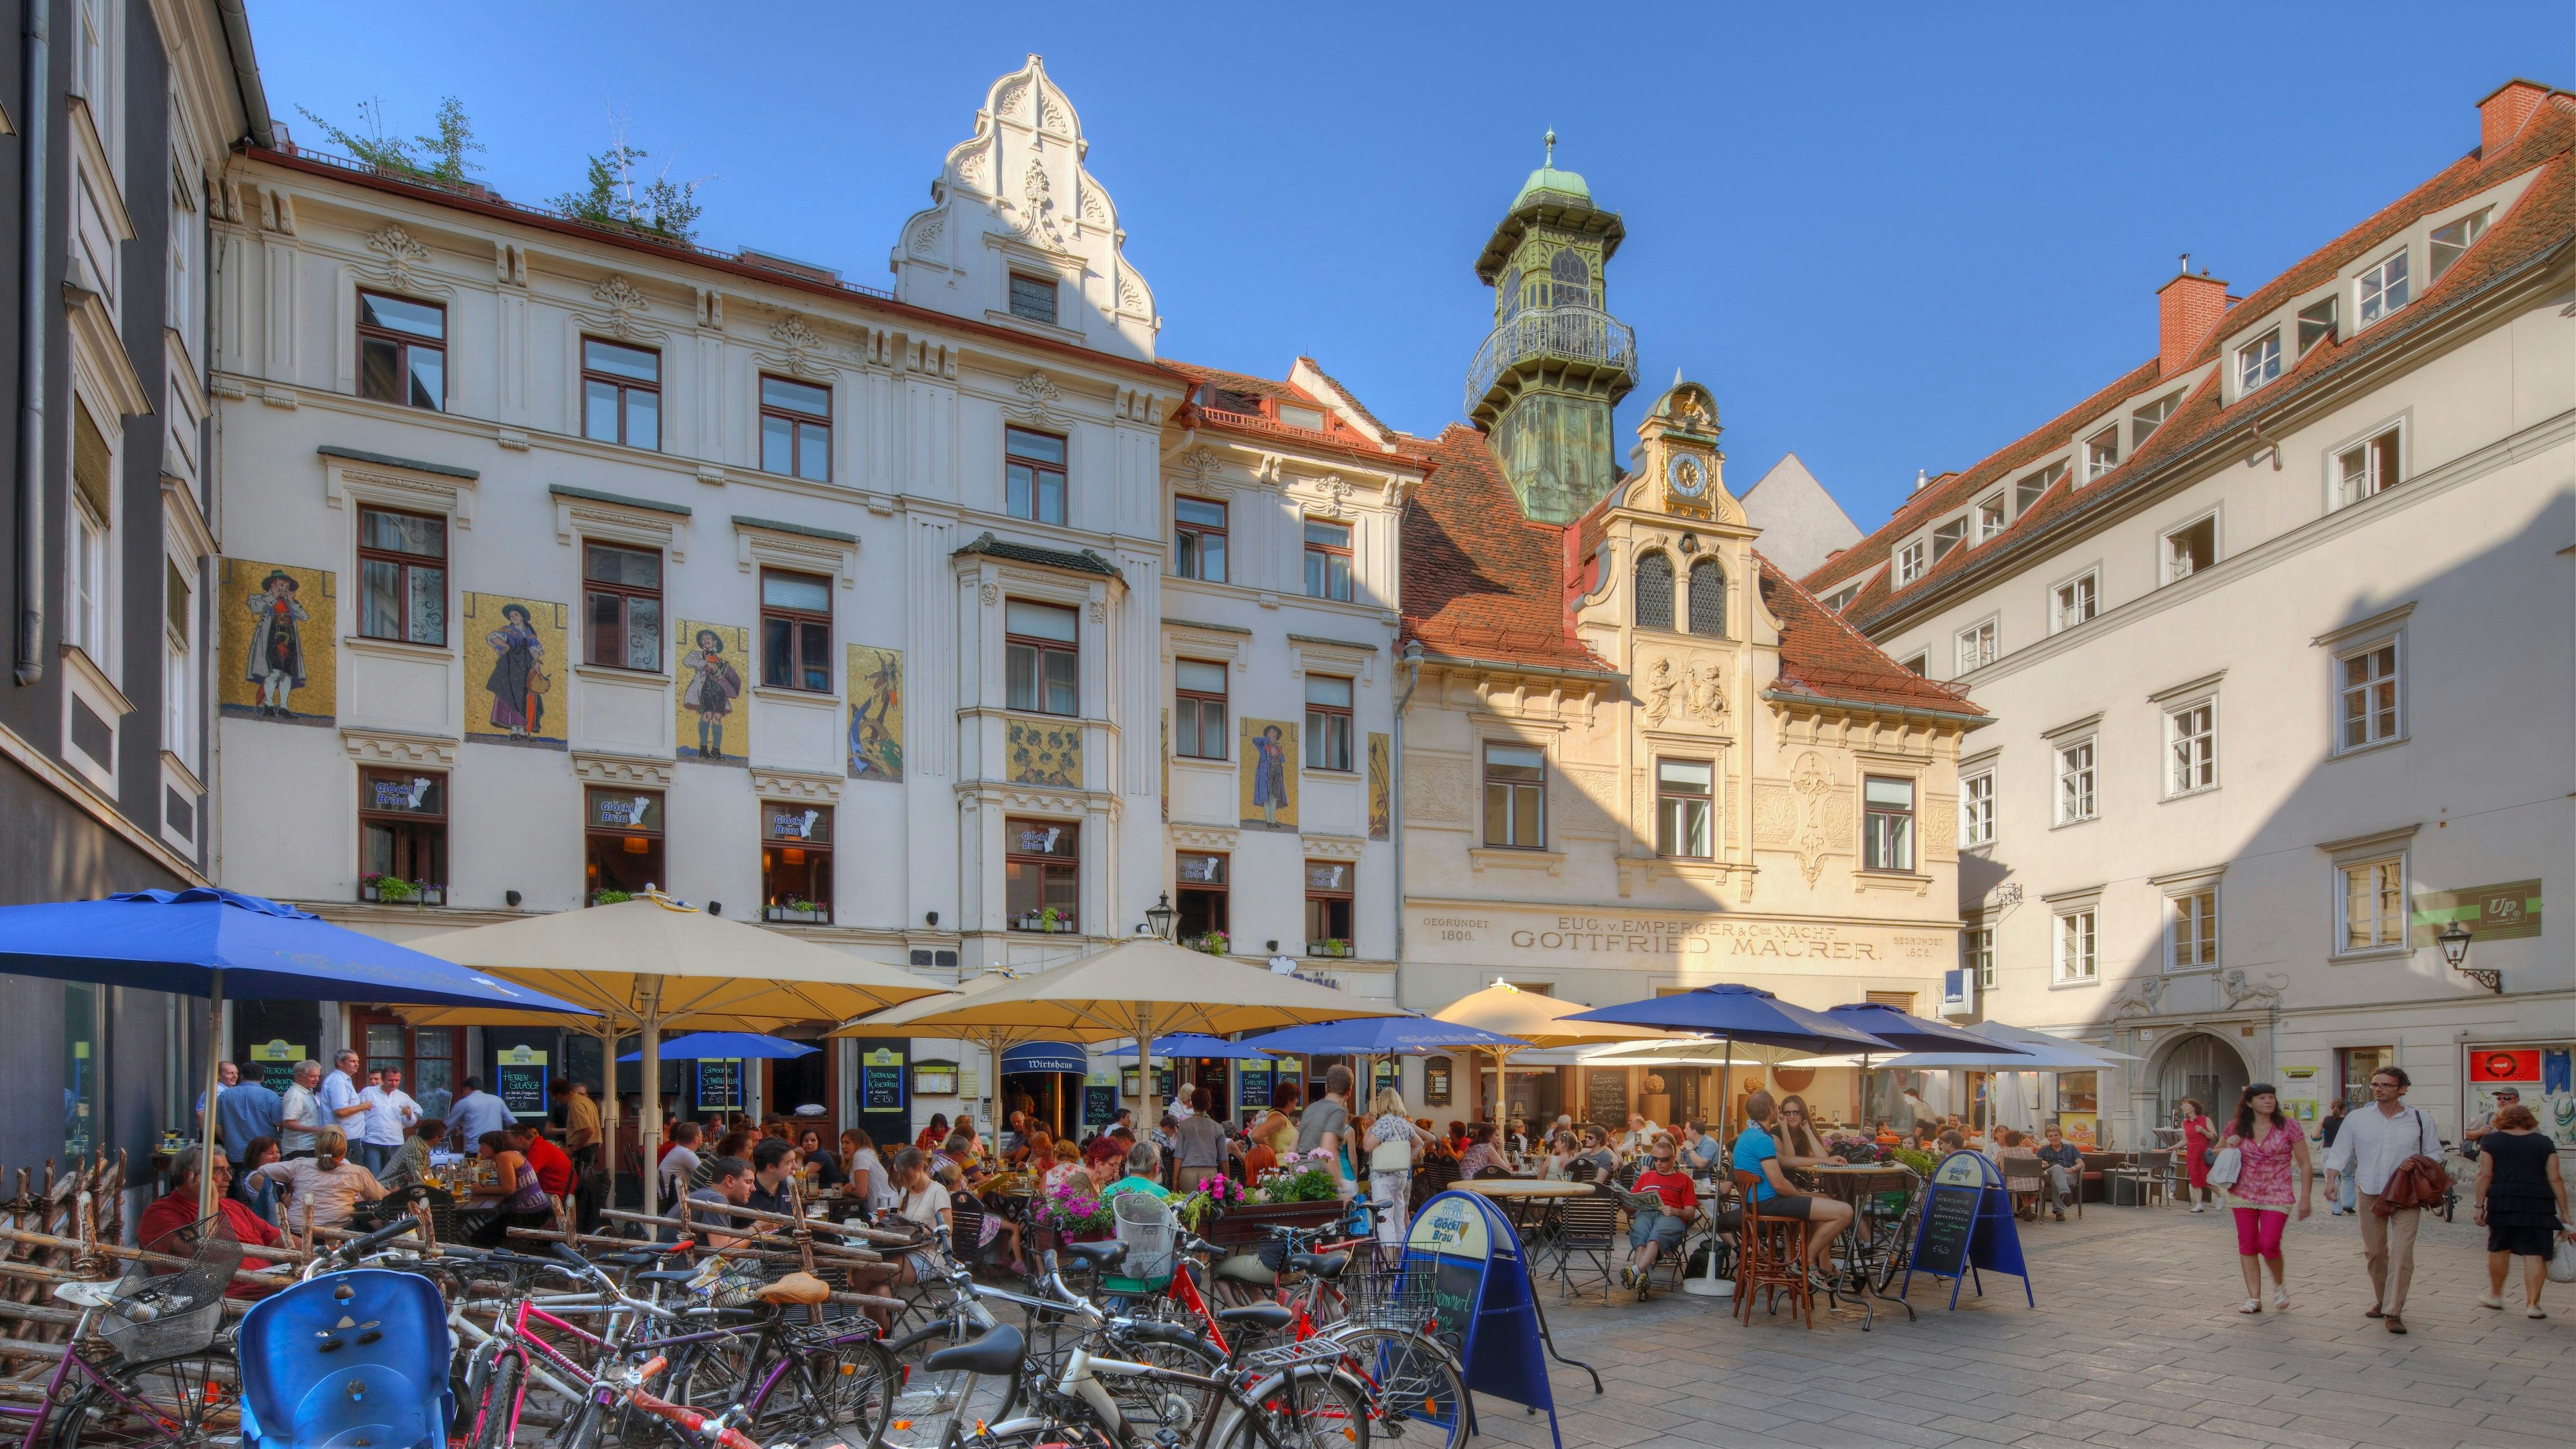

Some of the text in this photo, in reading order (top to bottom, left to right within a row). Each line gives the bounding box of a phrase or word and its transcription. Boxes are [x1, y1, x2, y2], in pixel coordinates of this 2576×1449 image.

[376, 782, 413, 793] Glöckl
[377, 793, 406, 805] Bräu
[601, 800, 634, 812] Glöckl
[601, 811, 627, 822] Bräu
[775, 814, 805, 825] Glöckl
[775, 825, 799, 835] Bräu
[1022, 831, 1048, 841] Glöckl
[1022, 840, 1043, 850] Bräu
[2489, 898, 2516, 916] Up
[1423, 917, 1489, 928] GEGRÜNDET
[1558, 917, 1603, 931] EUG.
[1622, 920, 1735, 936] EMPERGER
[1442, 931, 1475, 941] 1806.
[1511, 931, 1710, 954] GOTTFRIED
[1893, 938, 1943, 946] GEGRÜNDET
[1029, 1060, 1072, 1070] Wirtshaus
[510, 1081, 540, 1090] GULASCH
[1434, 1217, 1460, 1231] Glöckl
[1432, 1230, 1454, 1243] Bräu
